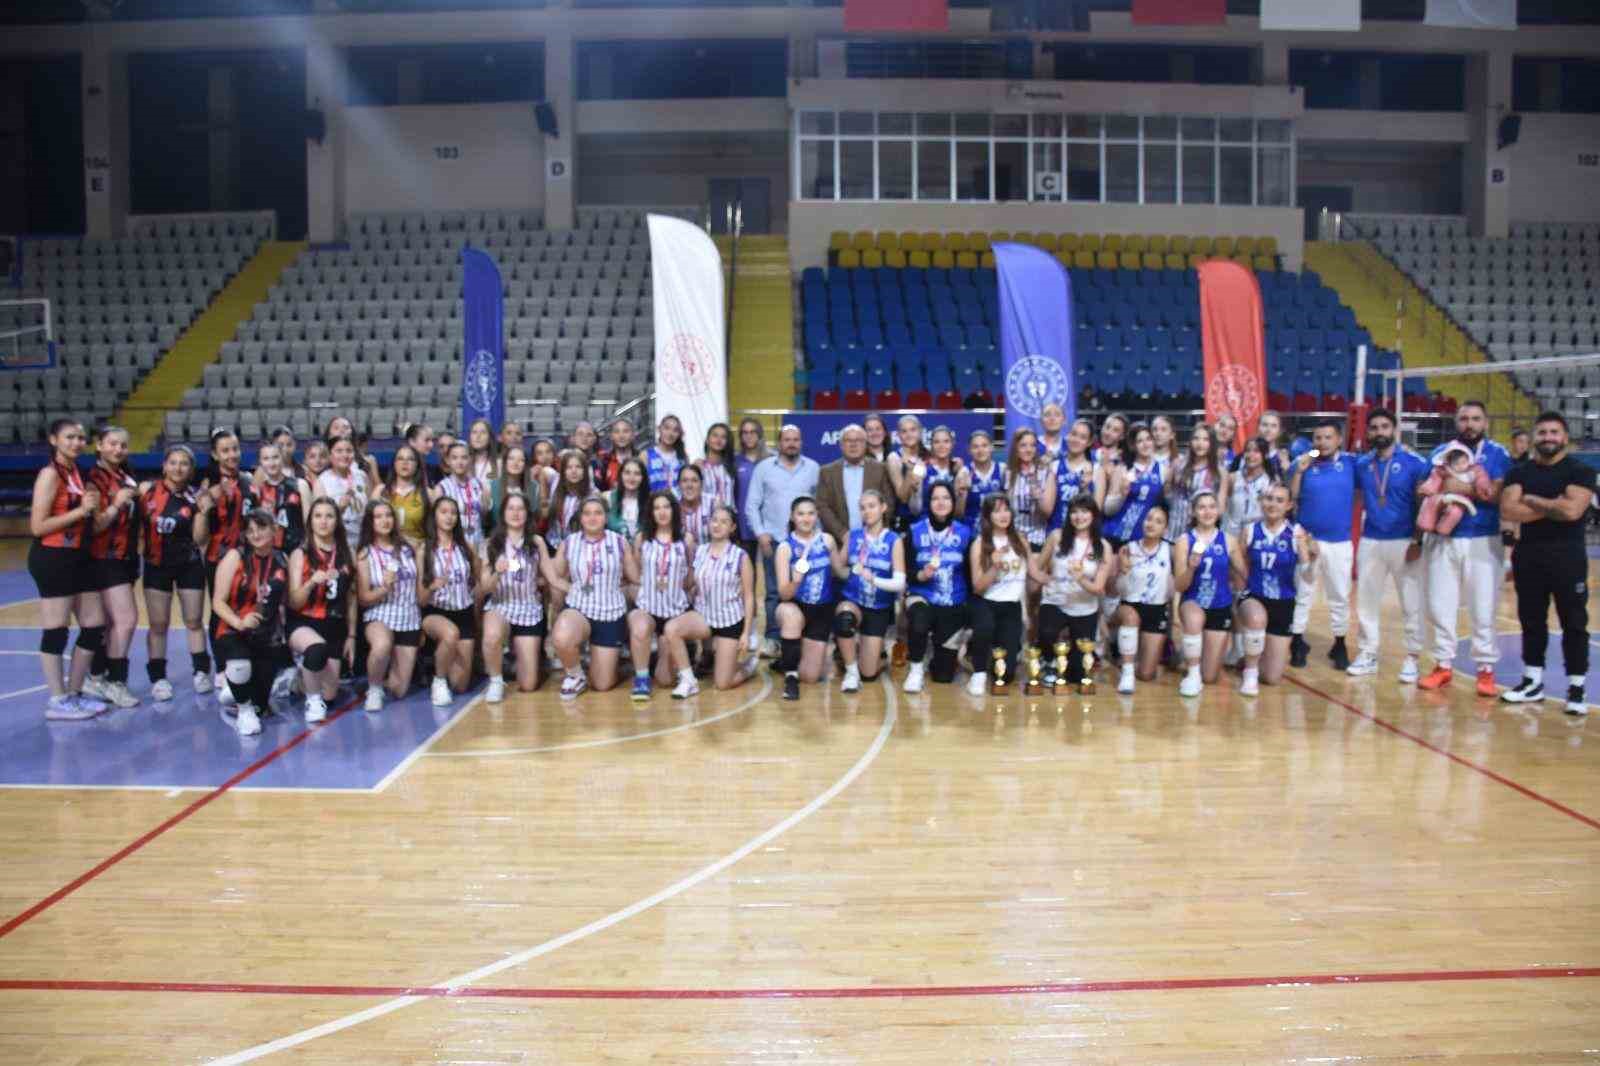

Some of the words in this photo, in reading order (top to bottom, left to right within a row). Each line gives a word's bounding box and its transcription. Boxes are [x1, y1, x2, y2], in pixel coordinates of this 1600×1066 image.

[552, 161, 565, 176] D
[1492, 169, 1504, 183] B
[91, 176, 104, 192] E
[1041, 175, 1055, 191] C
[1261, 552, 1277, 570] 17
[1146, 572, 1156, 588] 2
[325, 579, 338, 599] 3
